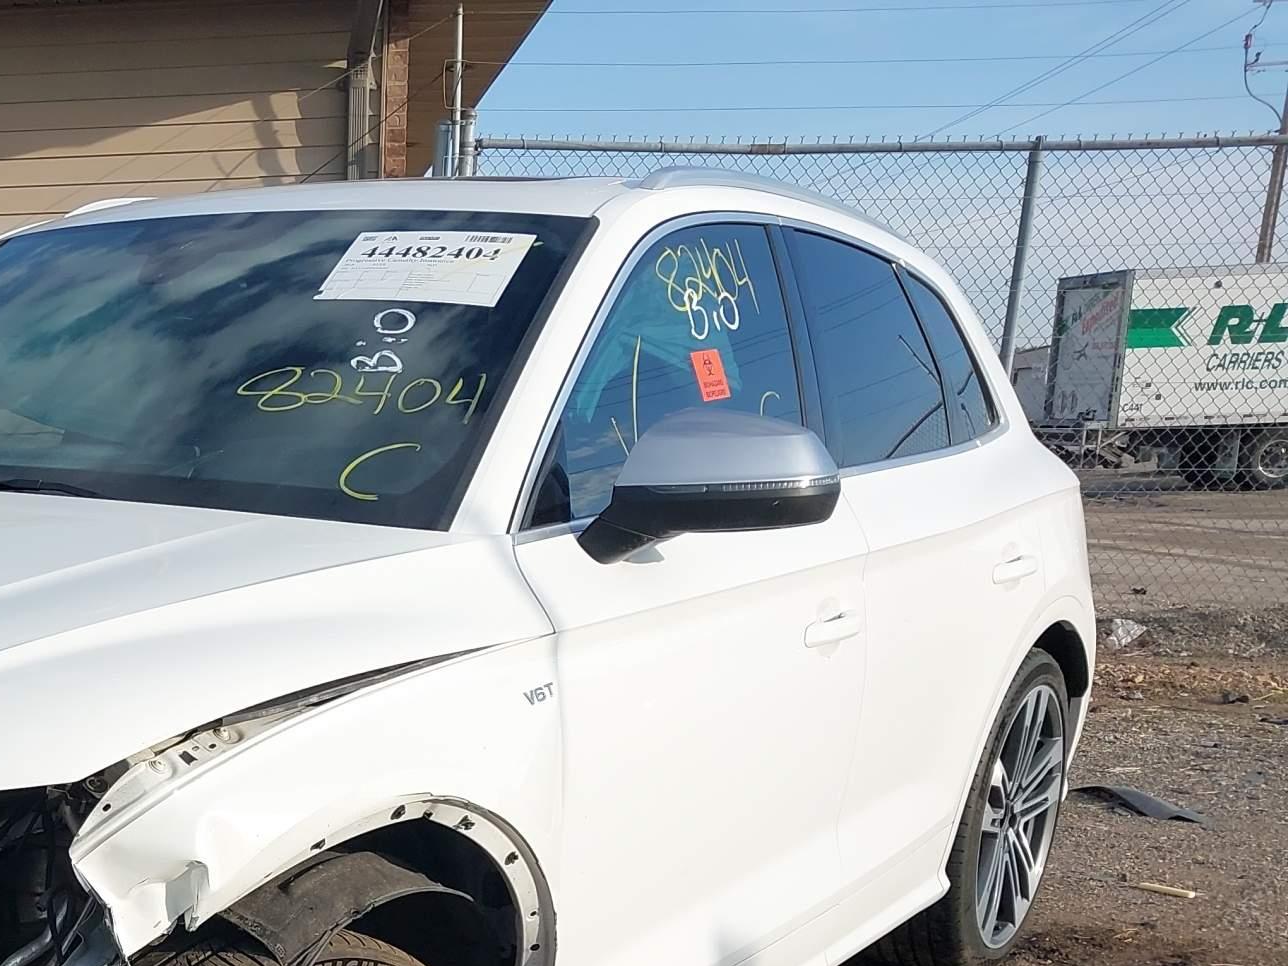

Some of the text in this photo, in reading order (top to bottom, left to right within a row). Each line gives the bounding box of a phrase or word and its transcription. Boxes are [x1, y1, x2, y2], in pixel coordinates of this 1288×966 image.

[360, 245, 502, 261] 44482404
[1206, 351, 1284, 372] CARRIERS
[237, 366, 487, 425] 82404
[523, 682, 554, 706] V6T
